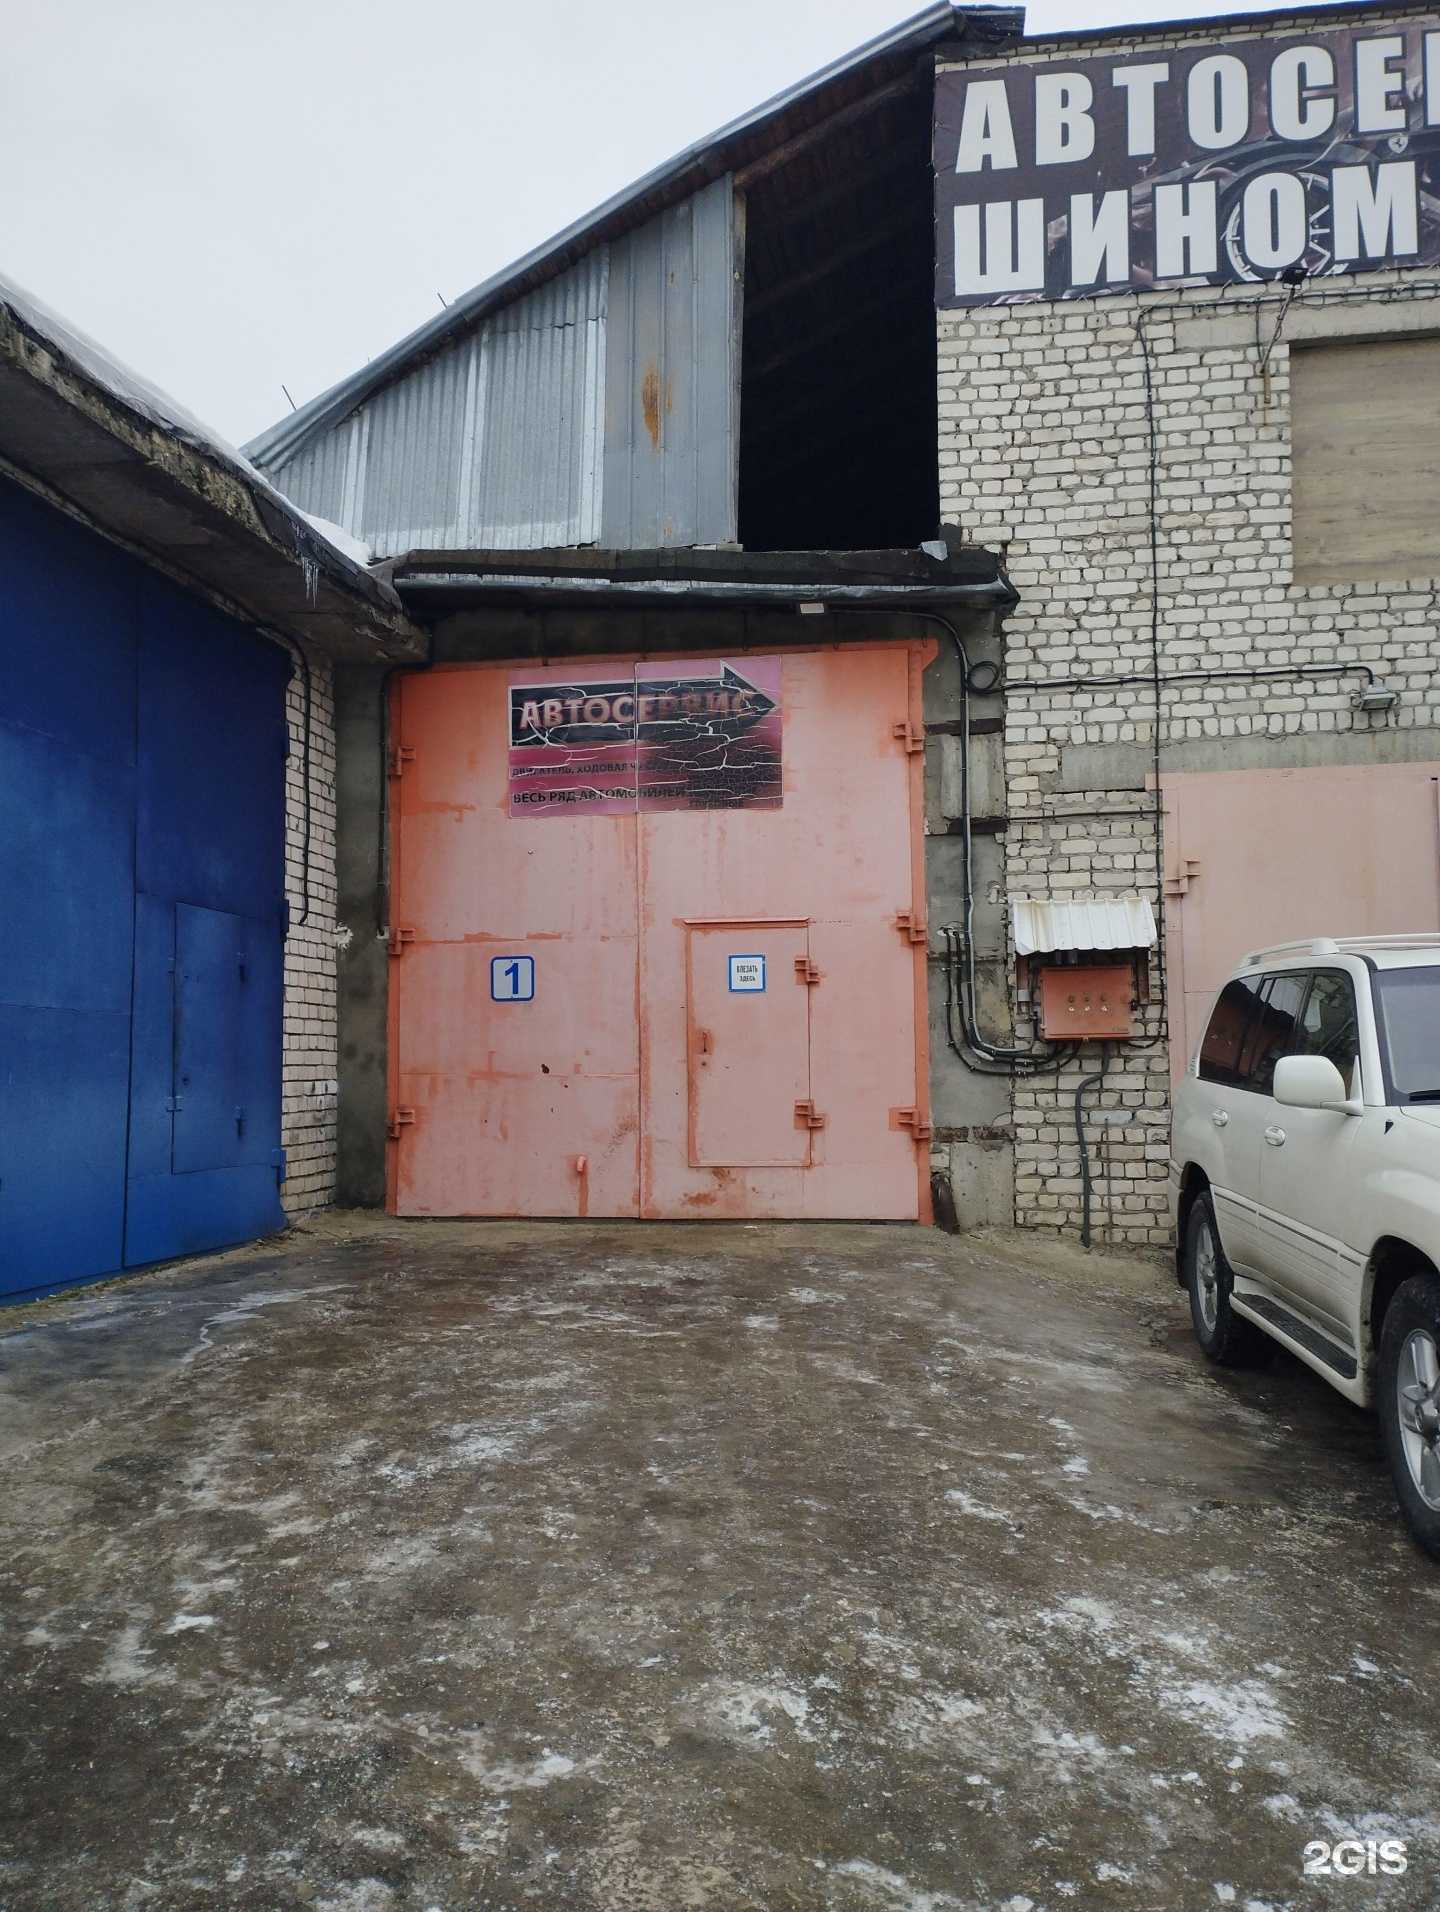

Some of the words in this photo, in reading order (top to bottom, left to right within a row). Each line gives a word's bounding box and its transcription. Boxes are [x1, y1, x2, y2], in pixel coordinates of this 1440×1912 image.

[955, 32, 1440, 174] АВТОСЕ
[954, 161, 1418, 296] ШИНОМ
[513, 791, 546, 804] ВЕСЬ
[549, 790, 576, 803] РЯД
[504, 962, 519, 995] 1
